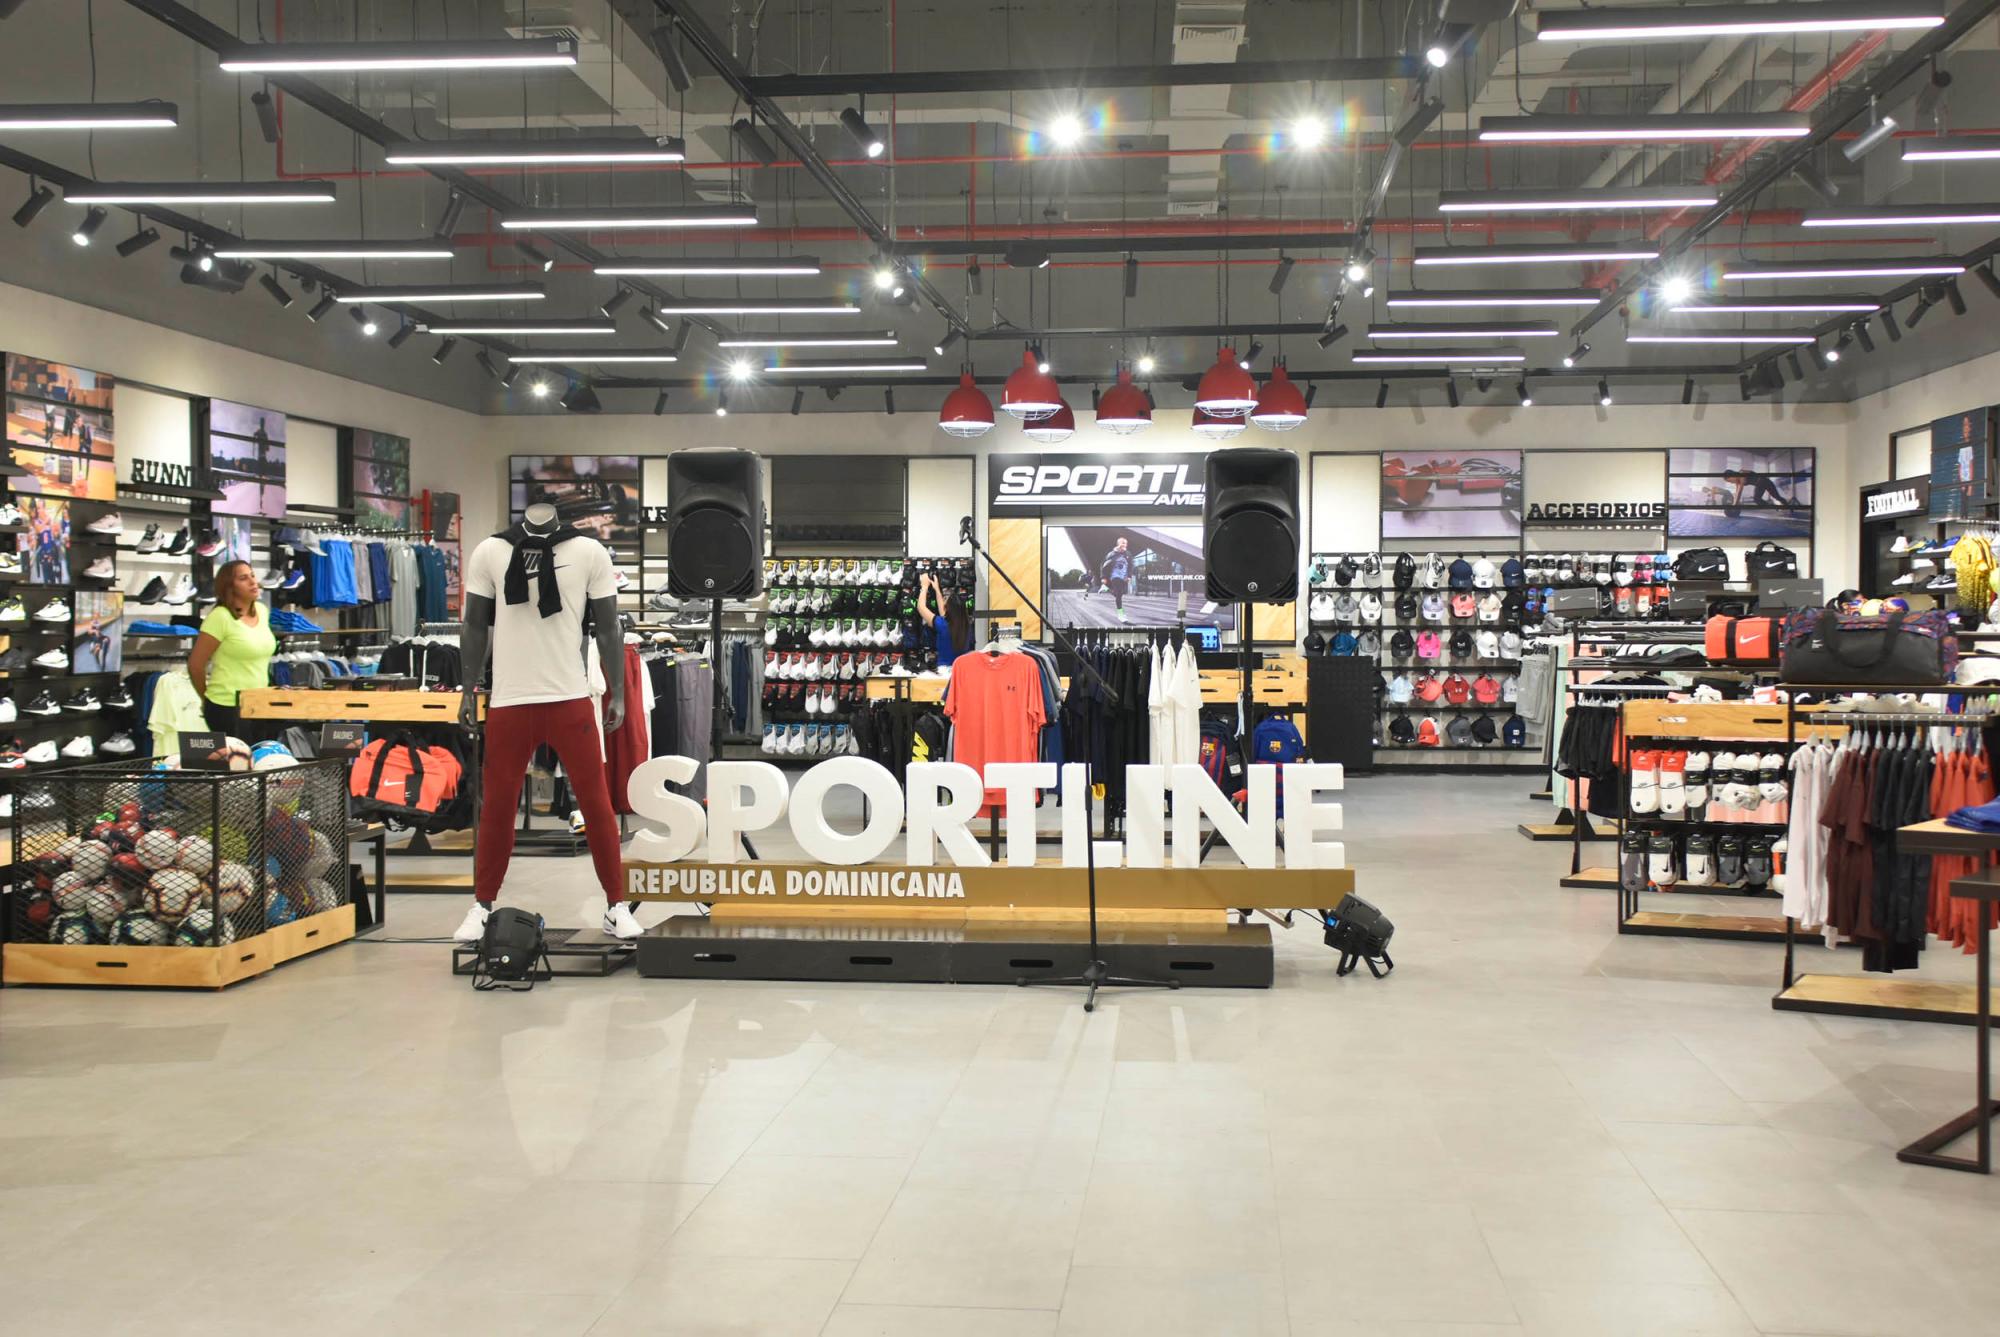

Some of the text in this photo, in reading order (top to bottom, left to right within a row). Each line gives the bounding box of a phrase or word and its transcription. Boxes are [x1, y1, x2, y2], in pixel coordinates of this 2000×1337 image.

[999, 464, 1206, 494] SPORTL
[1153, 494, 1206, 505] AME
[1527, 503, 1666, 519] ACCESORIOS
[623, 755, 1346, 870] SPORTLINE
[628, 868, 966, 899] REPUBLICA DOMINICANA
